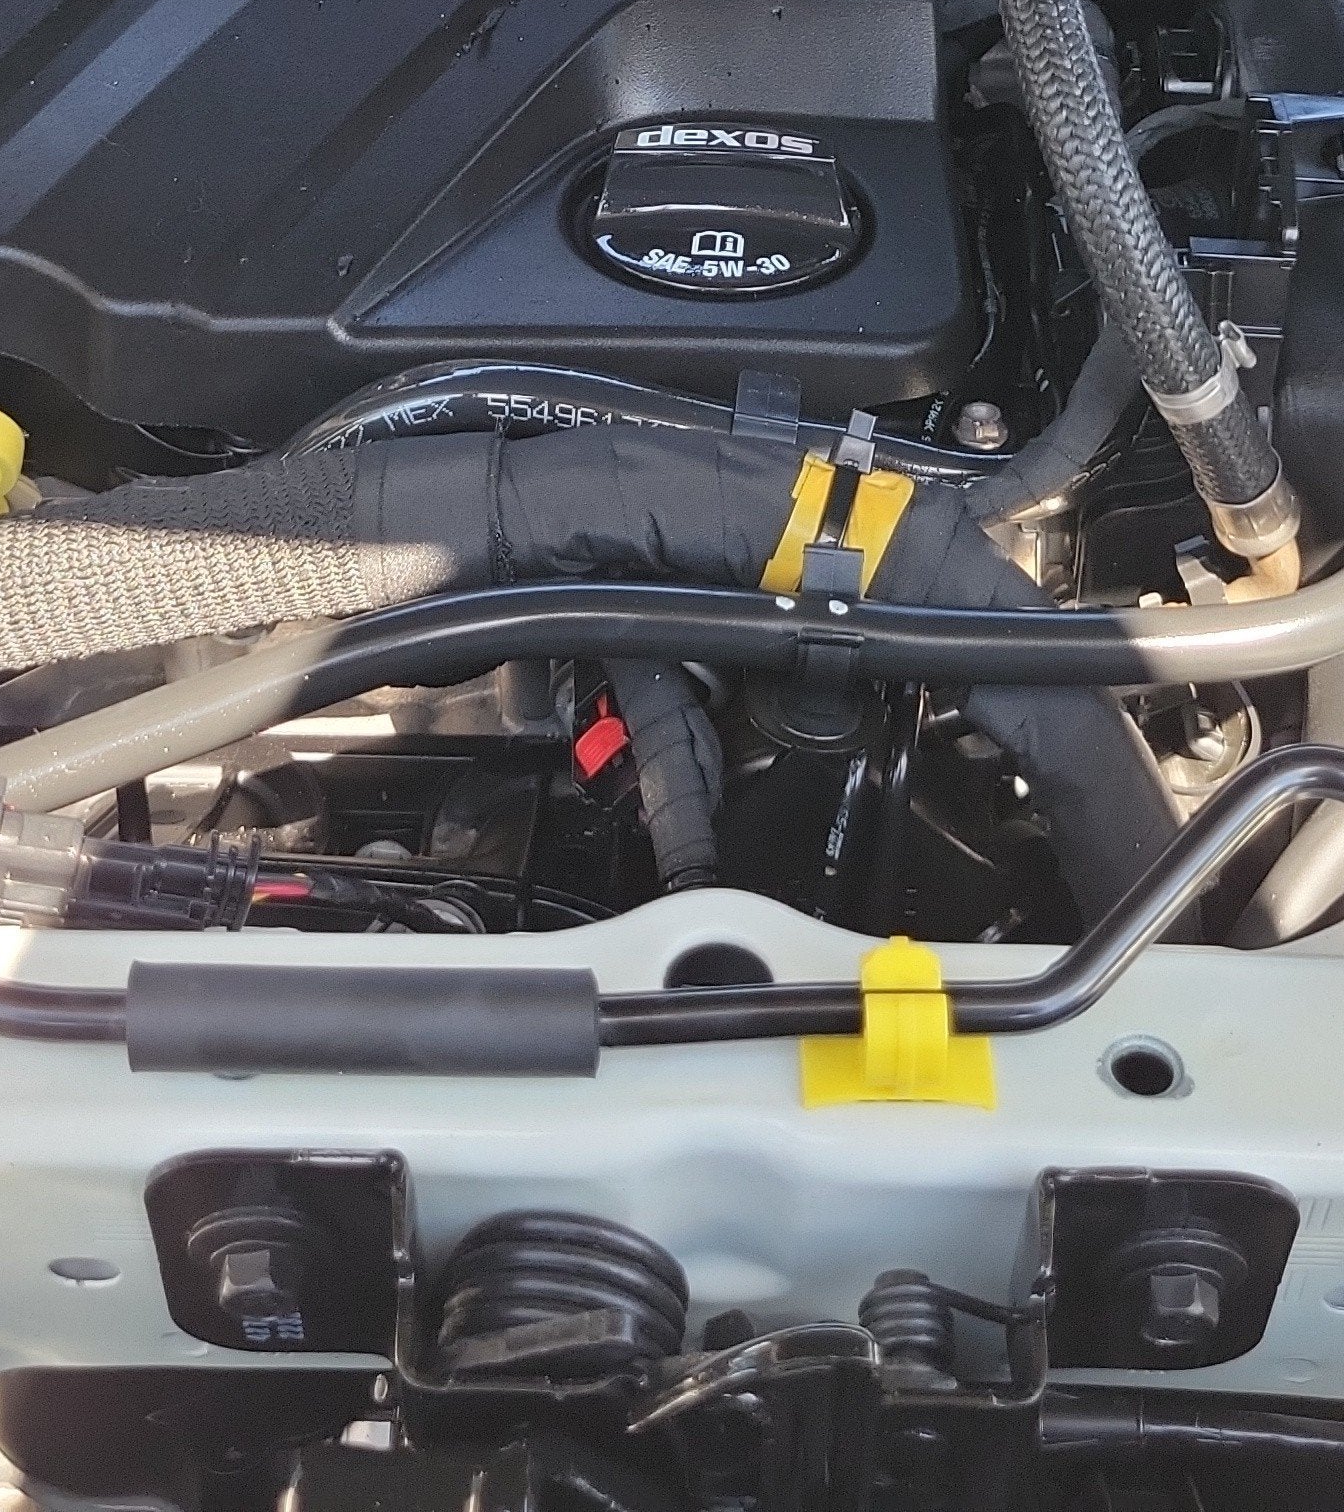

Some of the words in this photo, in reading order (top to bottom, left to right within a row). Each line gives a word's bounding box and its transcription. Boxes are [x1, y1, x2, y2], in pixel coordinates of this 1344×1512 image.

[636, 125, 819, 154] dexos
[641, 248, 693, 275] SAE
[701, 253, 792, 278] 5W-30
[382, 398, 454, 432] MEX
